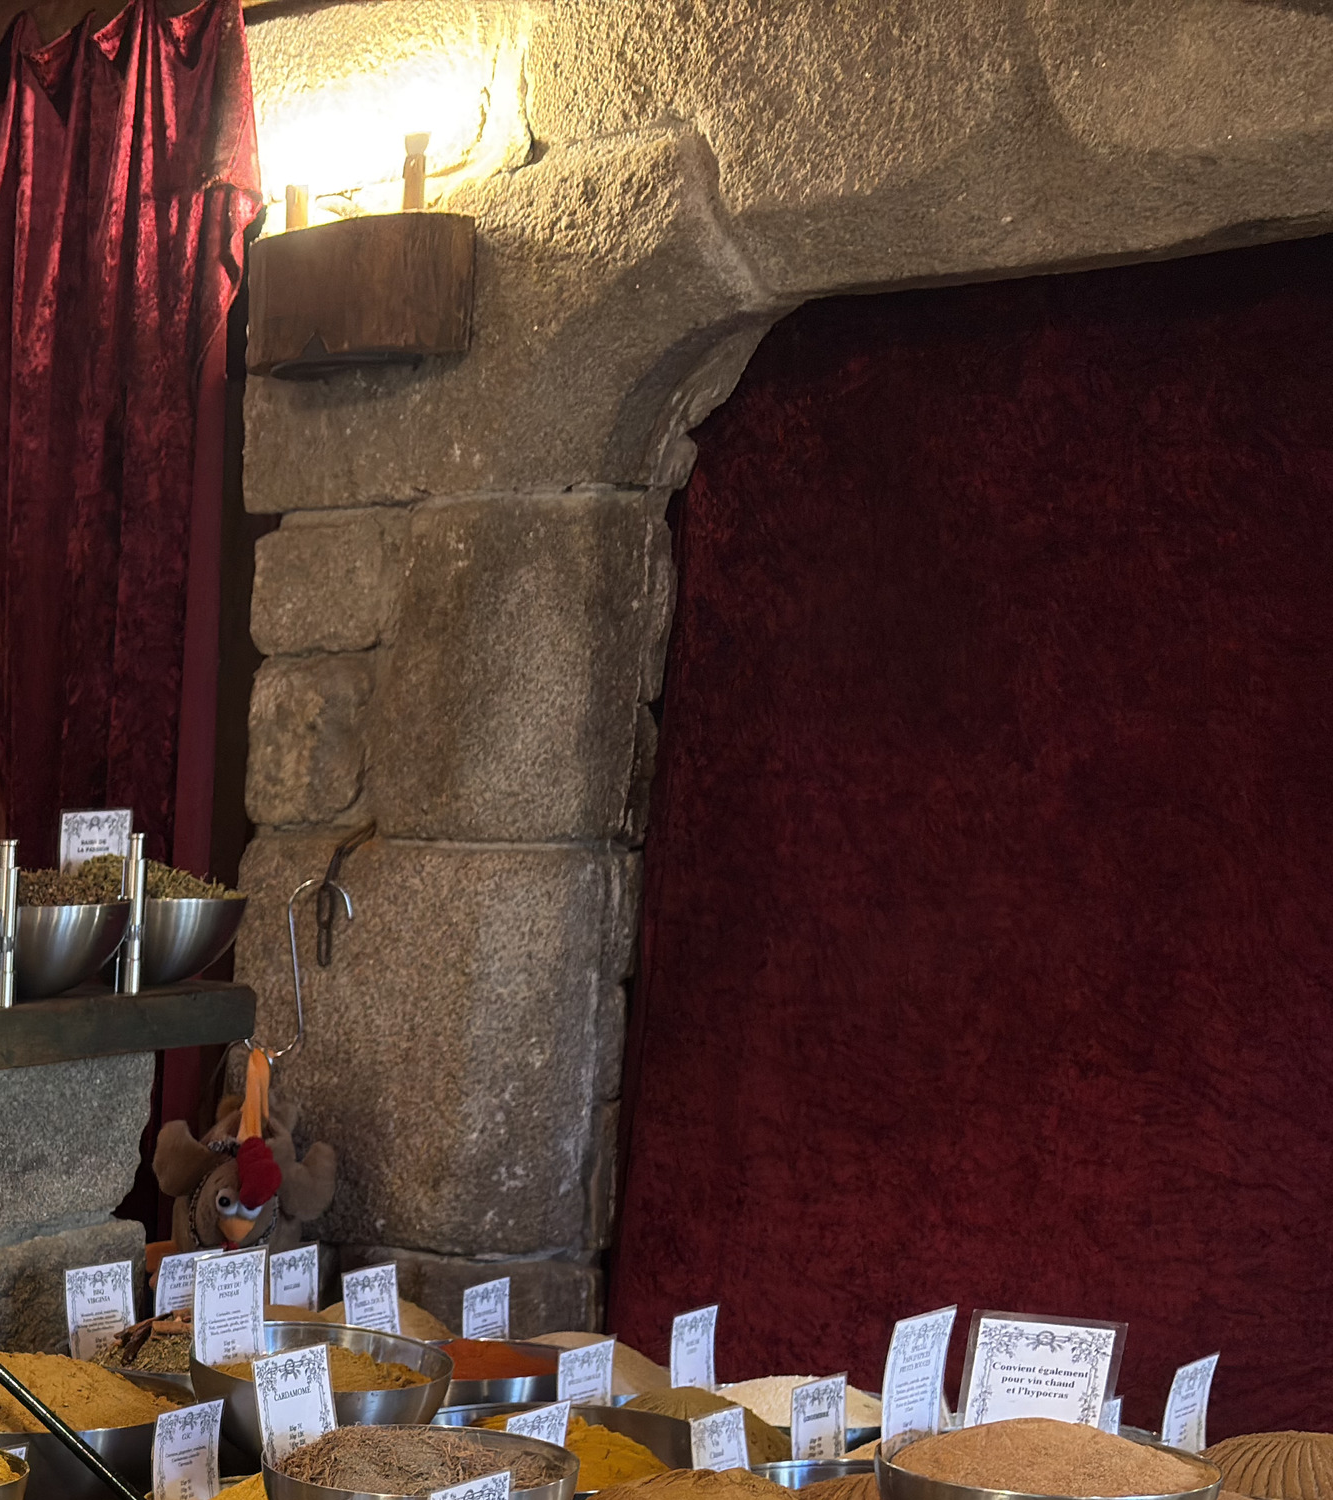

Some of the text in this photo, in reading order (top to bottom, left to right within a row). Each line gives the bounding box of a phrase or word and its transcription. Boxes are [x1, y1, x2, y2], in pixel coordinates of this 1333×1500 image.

[993, 1361, 1089, 1378] Convient également
[1001, 1375, 1075, 1388] pour vin chaud
[273, 1386, 312, 1402] CARDAMOME
